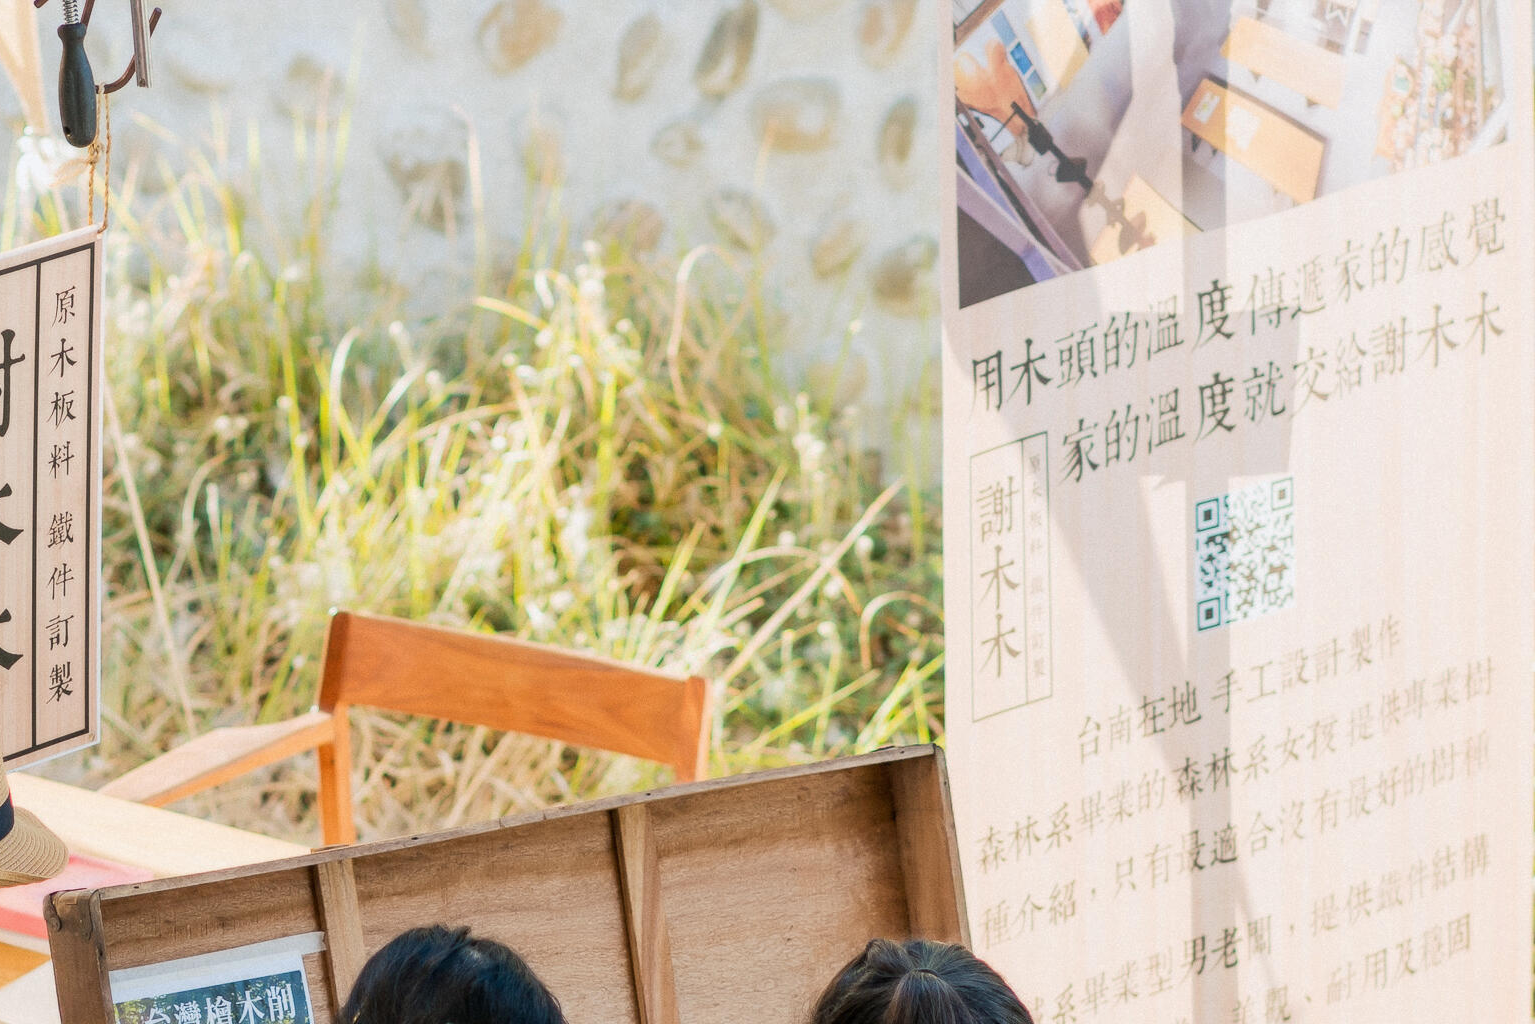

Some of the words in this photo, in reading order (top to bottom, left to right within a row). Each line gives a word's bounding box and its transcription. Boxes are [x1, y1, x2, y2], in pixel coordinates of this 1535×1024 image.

[1058, 291, 1506, 486] 家的溫度就交給謝木木
[973, 476, 1022, 678] 謝木木
